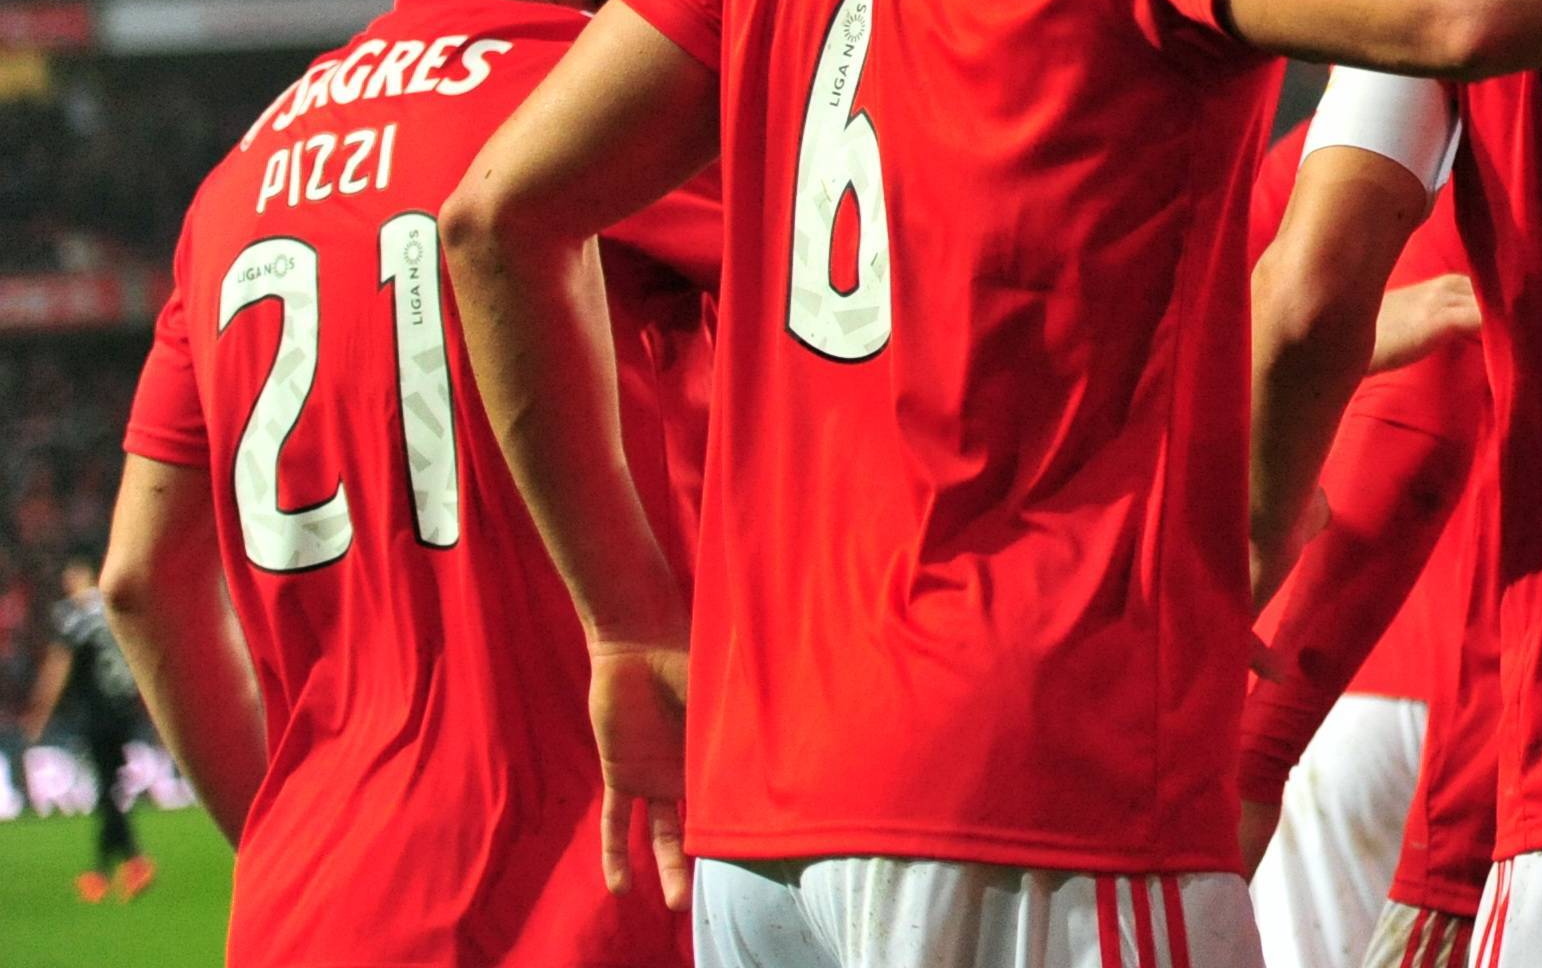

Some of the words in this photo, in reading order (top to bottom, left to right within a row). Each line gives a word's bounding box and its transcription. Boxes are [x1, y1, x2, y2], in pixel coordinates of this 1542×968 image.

[272, 35, 514, 131] SAGRES
[829, 64, 850, 107] LIGA
[255, 121, 398, 214] PIZZI
[237, 264, 263, 284] LIGA
[410, 285, 423, 326] LIGA
[217, 209, 460, 574] 21
